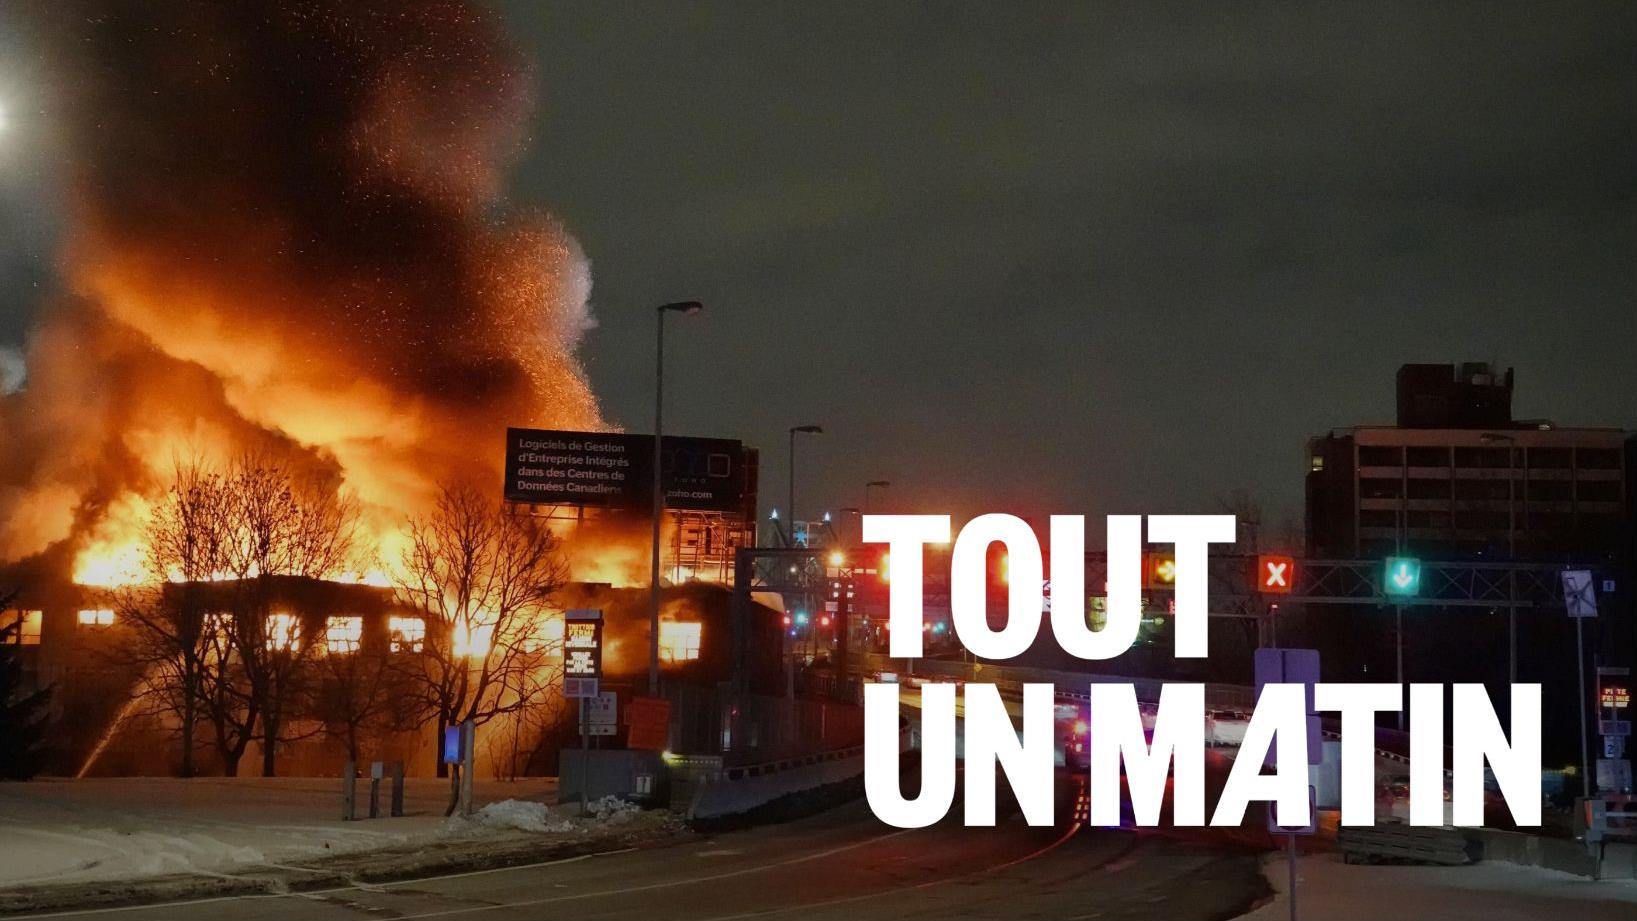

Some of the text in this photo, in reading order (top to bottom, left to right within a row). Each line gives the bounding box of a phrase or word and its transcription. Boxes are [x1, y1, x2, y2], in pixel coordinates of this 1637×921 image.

[519, 438, 625, 452] Logiciels de Gestion
[518, 452, 584, 465] d'Entreprise
[517, 466, 625, 480] dans des Centres de
[517, 480, 565, 492] Données
